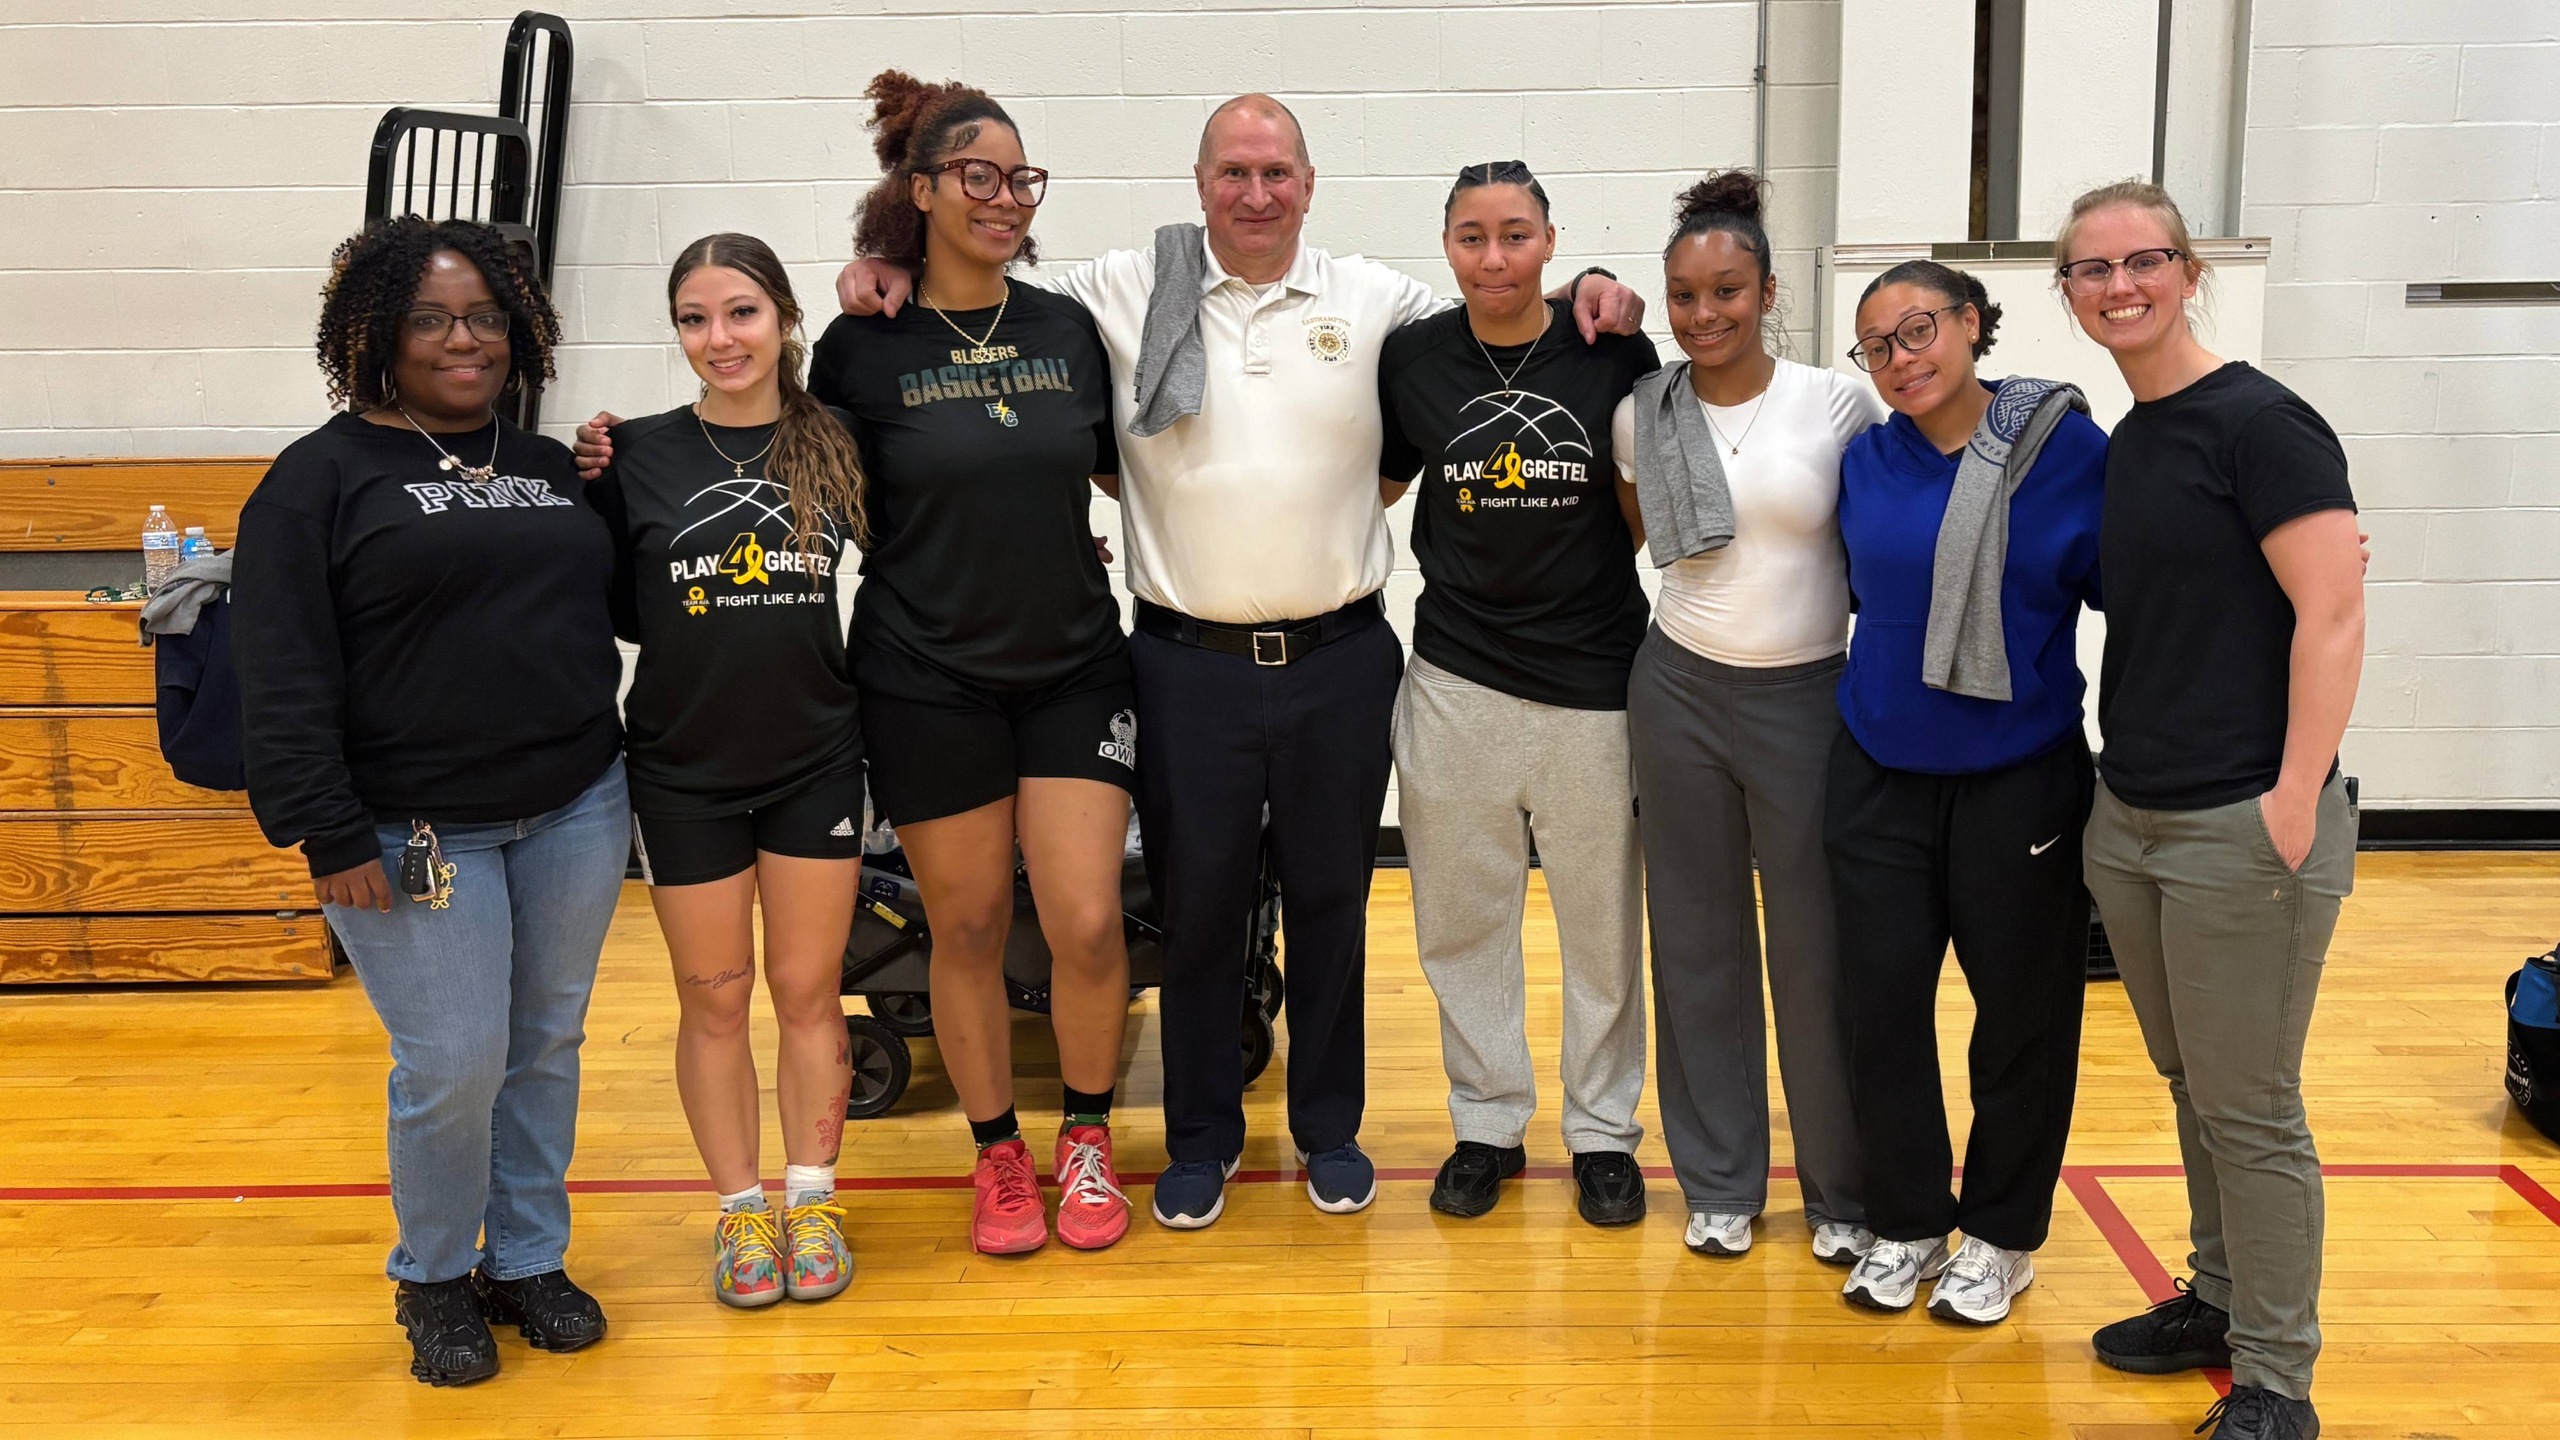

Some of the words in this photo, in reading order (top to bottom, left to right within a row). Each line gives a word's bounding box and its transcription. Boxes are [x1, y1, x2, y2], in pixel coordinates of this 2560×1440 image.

[898, 358, 1074, 408] BASKETBALL
[1443, 460, 1485, 483] PLAY
[1521, 459, 1589, 482] GRETEL
[403, 475, 575, 515] PINK
[1480, 497, 1517, 508] FIGHT
[1520, 497, 1548, 508] LIKE
[1550, 497, 1560, 508] A
[1562, 496, 1579, 507] KID
[670, 554, 721, 583] PLAY
[764, 550, 832, 578] GRETEL
[717, 594, 760, 608] FIGHT
[763, 593, 795, 605] LIKE
[797, 592, 807, 604] A
[808, 592, 826, 604] KID
